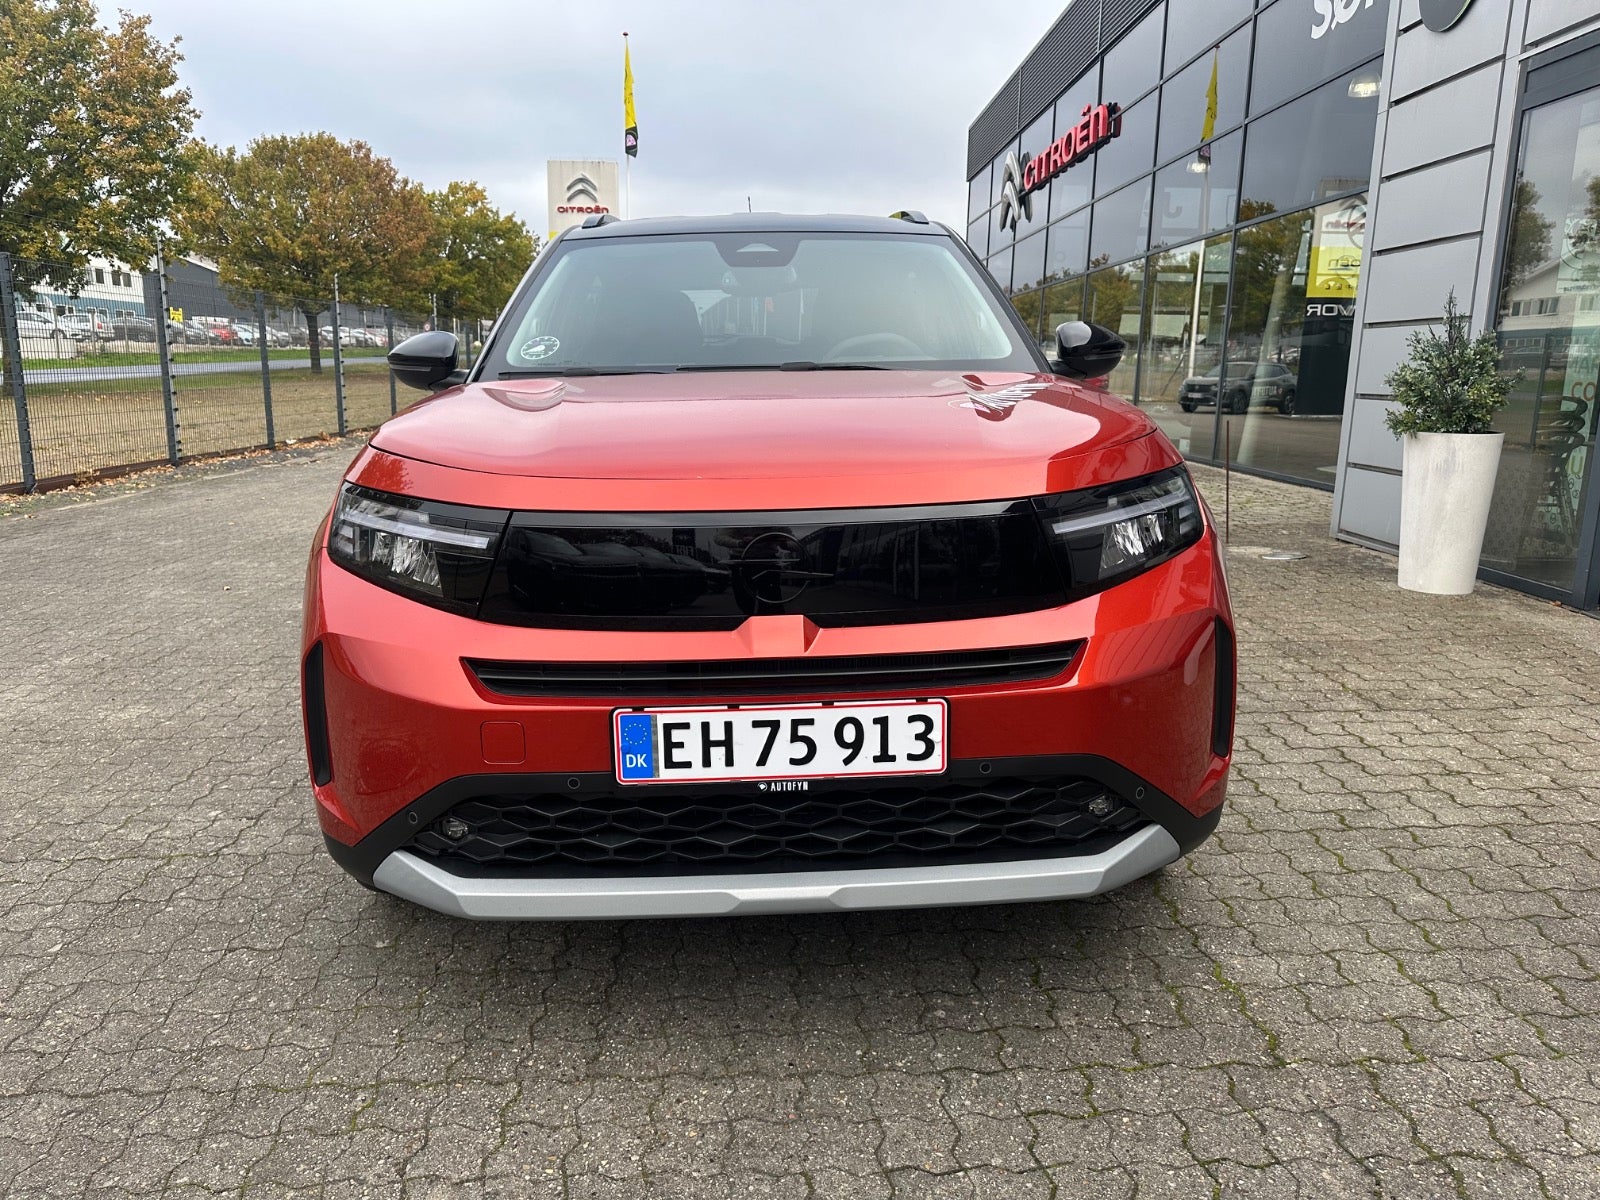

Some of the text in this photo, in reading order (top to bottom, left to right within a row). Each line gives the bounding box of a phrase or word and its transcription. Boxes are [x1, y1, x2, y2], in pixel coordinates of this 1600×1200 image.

[663, 714, 935, 769] EH 75 913
[626, 754, 647, 768] DK
[771, 781, 808, 791] AUTOFYN
